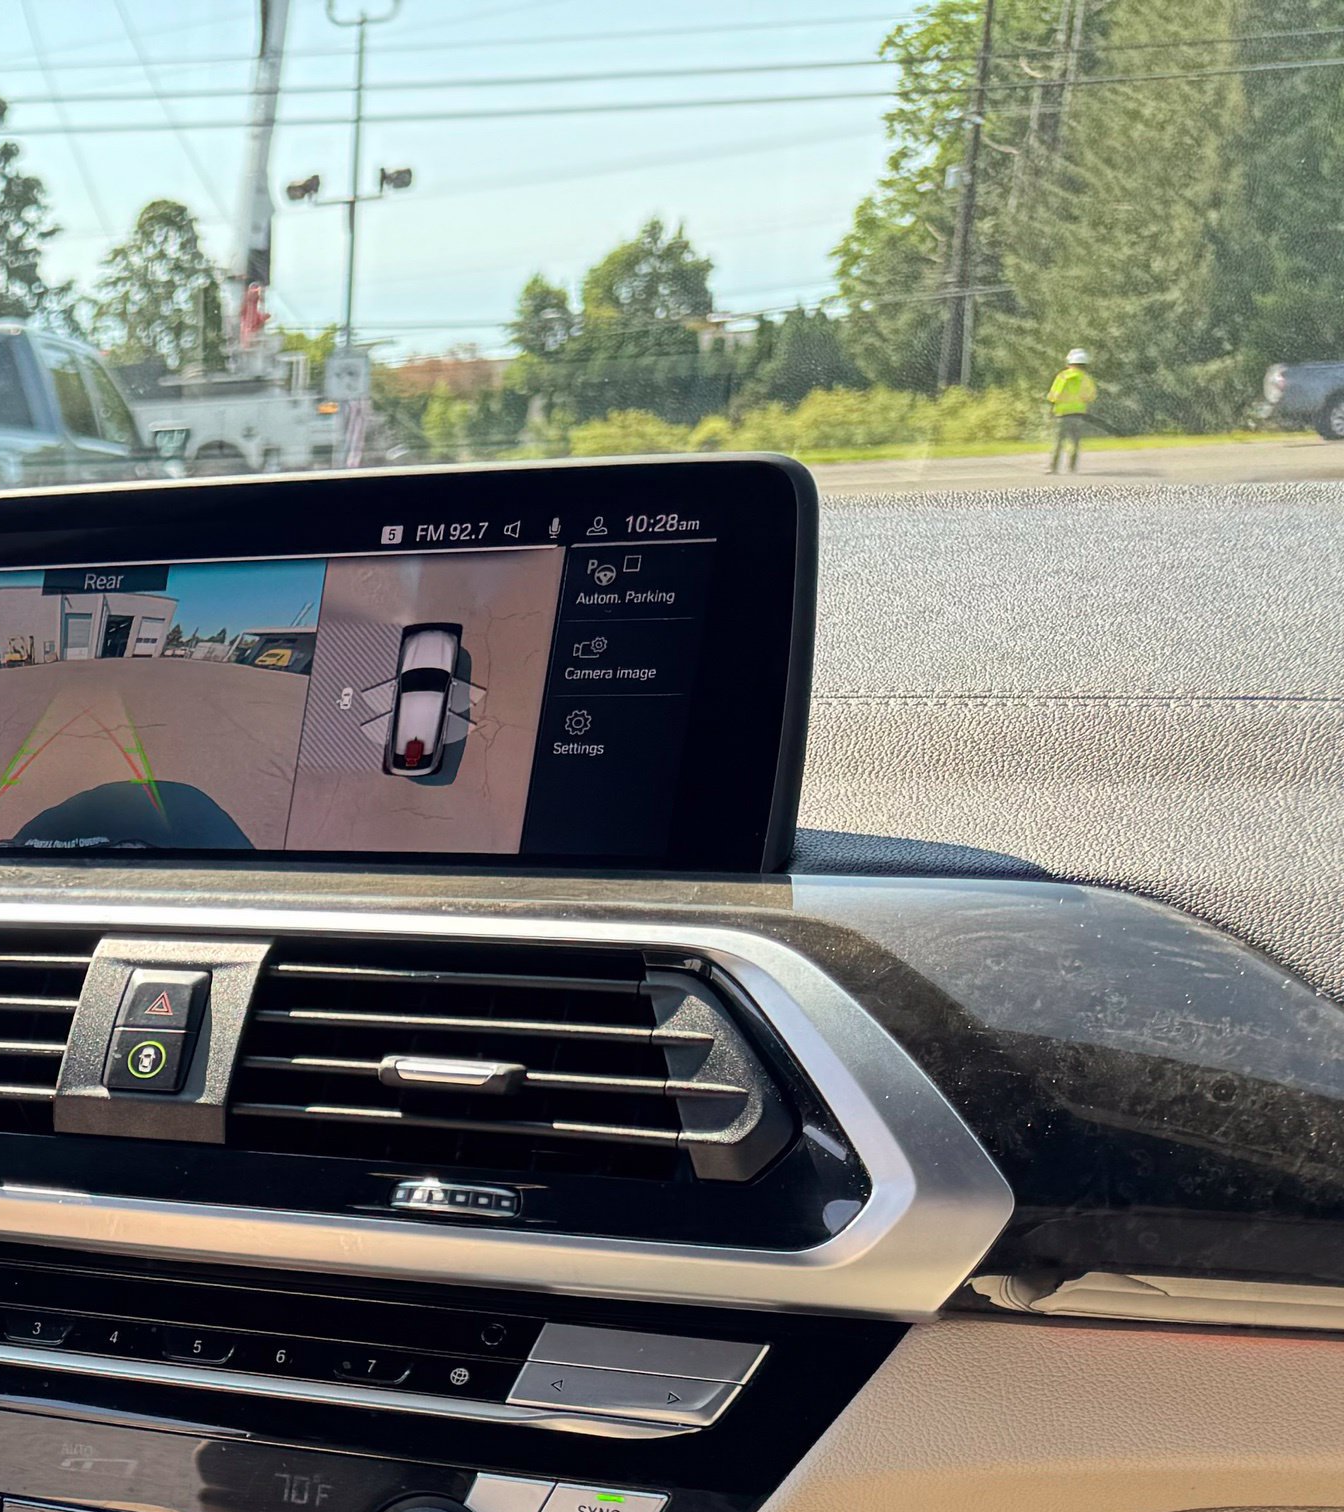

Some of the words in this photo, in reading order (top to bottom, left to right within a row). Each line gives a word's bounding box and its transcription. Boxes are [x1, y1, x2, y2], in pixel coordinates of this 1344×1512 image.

[416, 525, 445, 541] FM
[449, 522, 489, 540] 92.7
[84, 571, 125, 591] Rear
[576, 591, 622, 605] Autom.
[625, 590, 676, 605] Parking
[565, 667, 613, 681] Camera
[616, 667, 657, 681] image
[552, 741, 605, 758] Settings
[31, 1321, 42, 1336] 3
[108, 1330, 119, 1345] 4
[192, 1339, 203, 1355] 5
[275, 1349, 286, 1365] 6
[367, 1359, 378, 1374] 7
